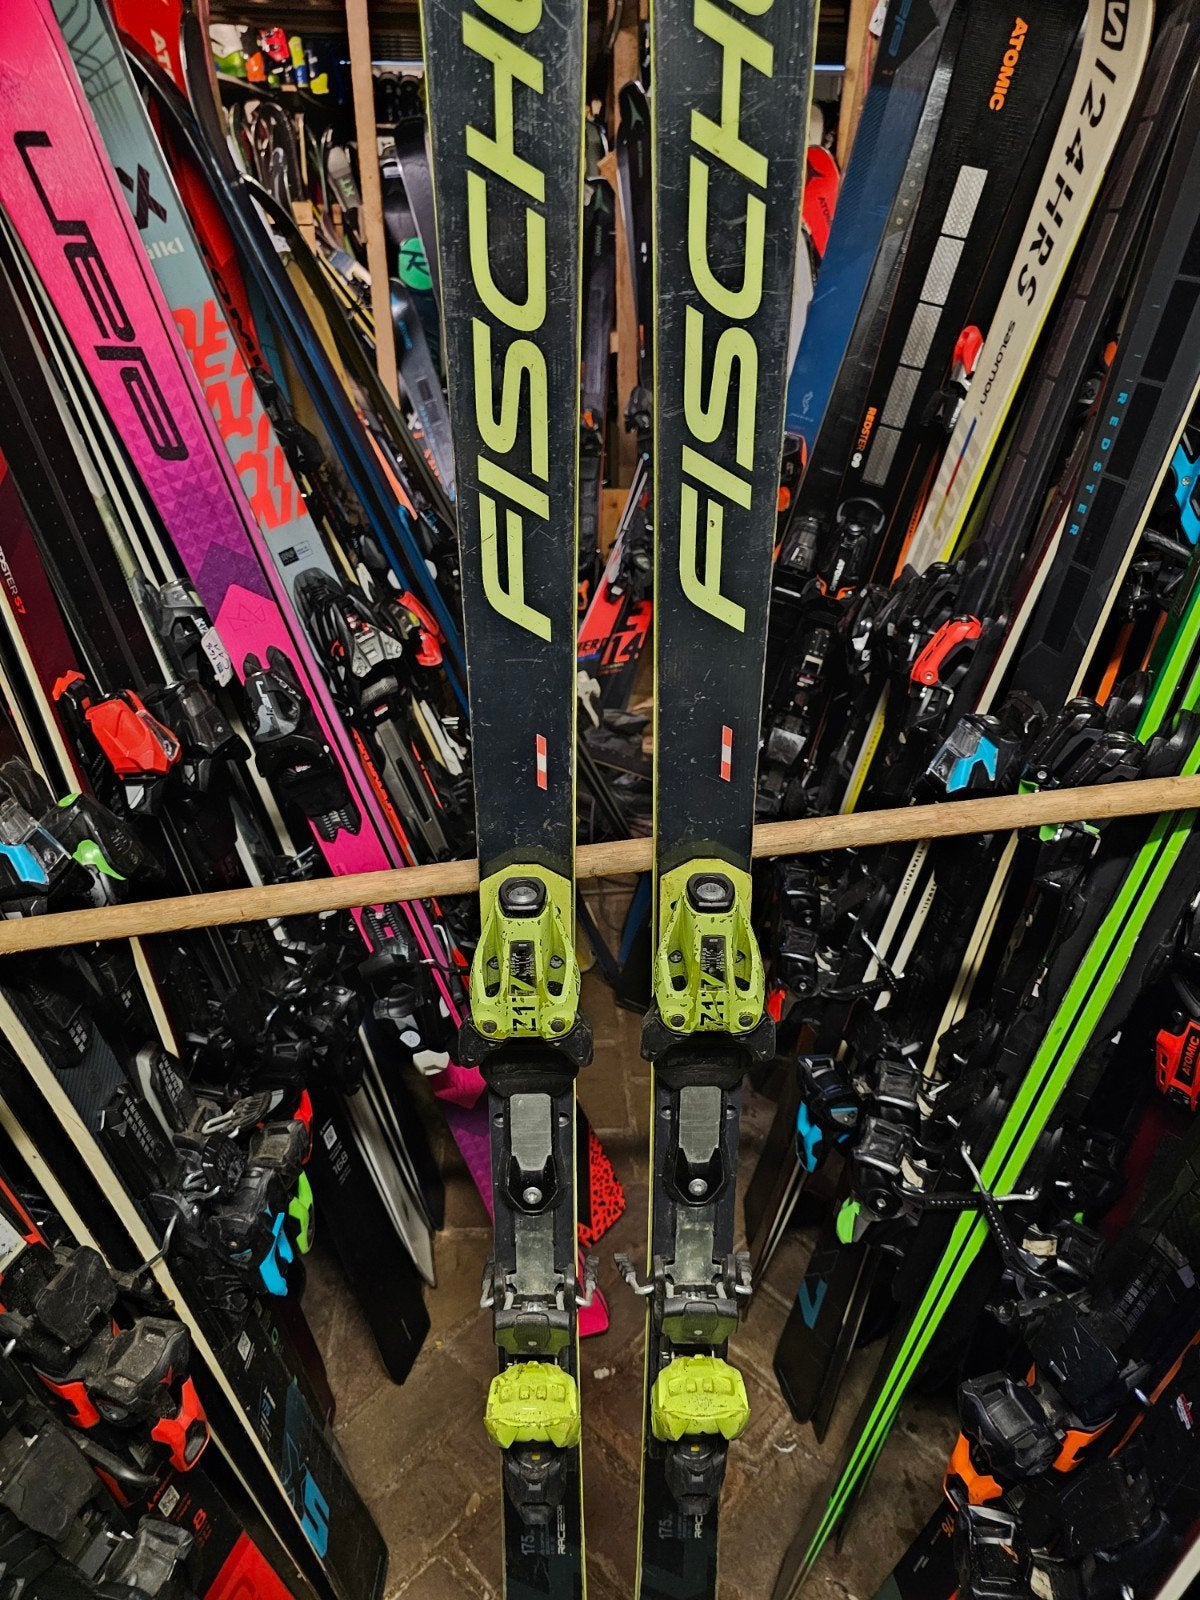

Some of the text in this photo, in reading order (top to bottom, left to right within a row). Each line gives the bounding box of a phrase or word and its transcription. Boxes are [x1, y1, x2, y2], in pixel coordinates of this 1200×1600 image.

[990, 17, 1029, 111] ATOMIC
[680, 0, 773, 633] FISCH
[980, 321, 1015, 404] salomon
[856, 407, 877, 451] REDSTER
[1071, 390, 1130, 535] REDSTER
[13, 593, 27, 615] S7
[1182, 1035, 1200, 1077] ATOMIC
[521, 1535, 535, 1555] 175
[658, 1519, 673, 1539] 175
